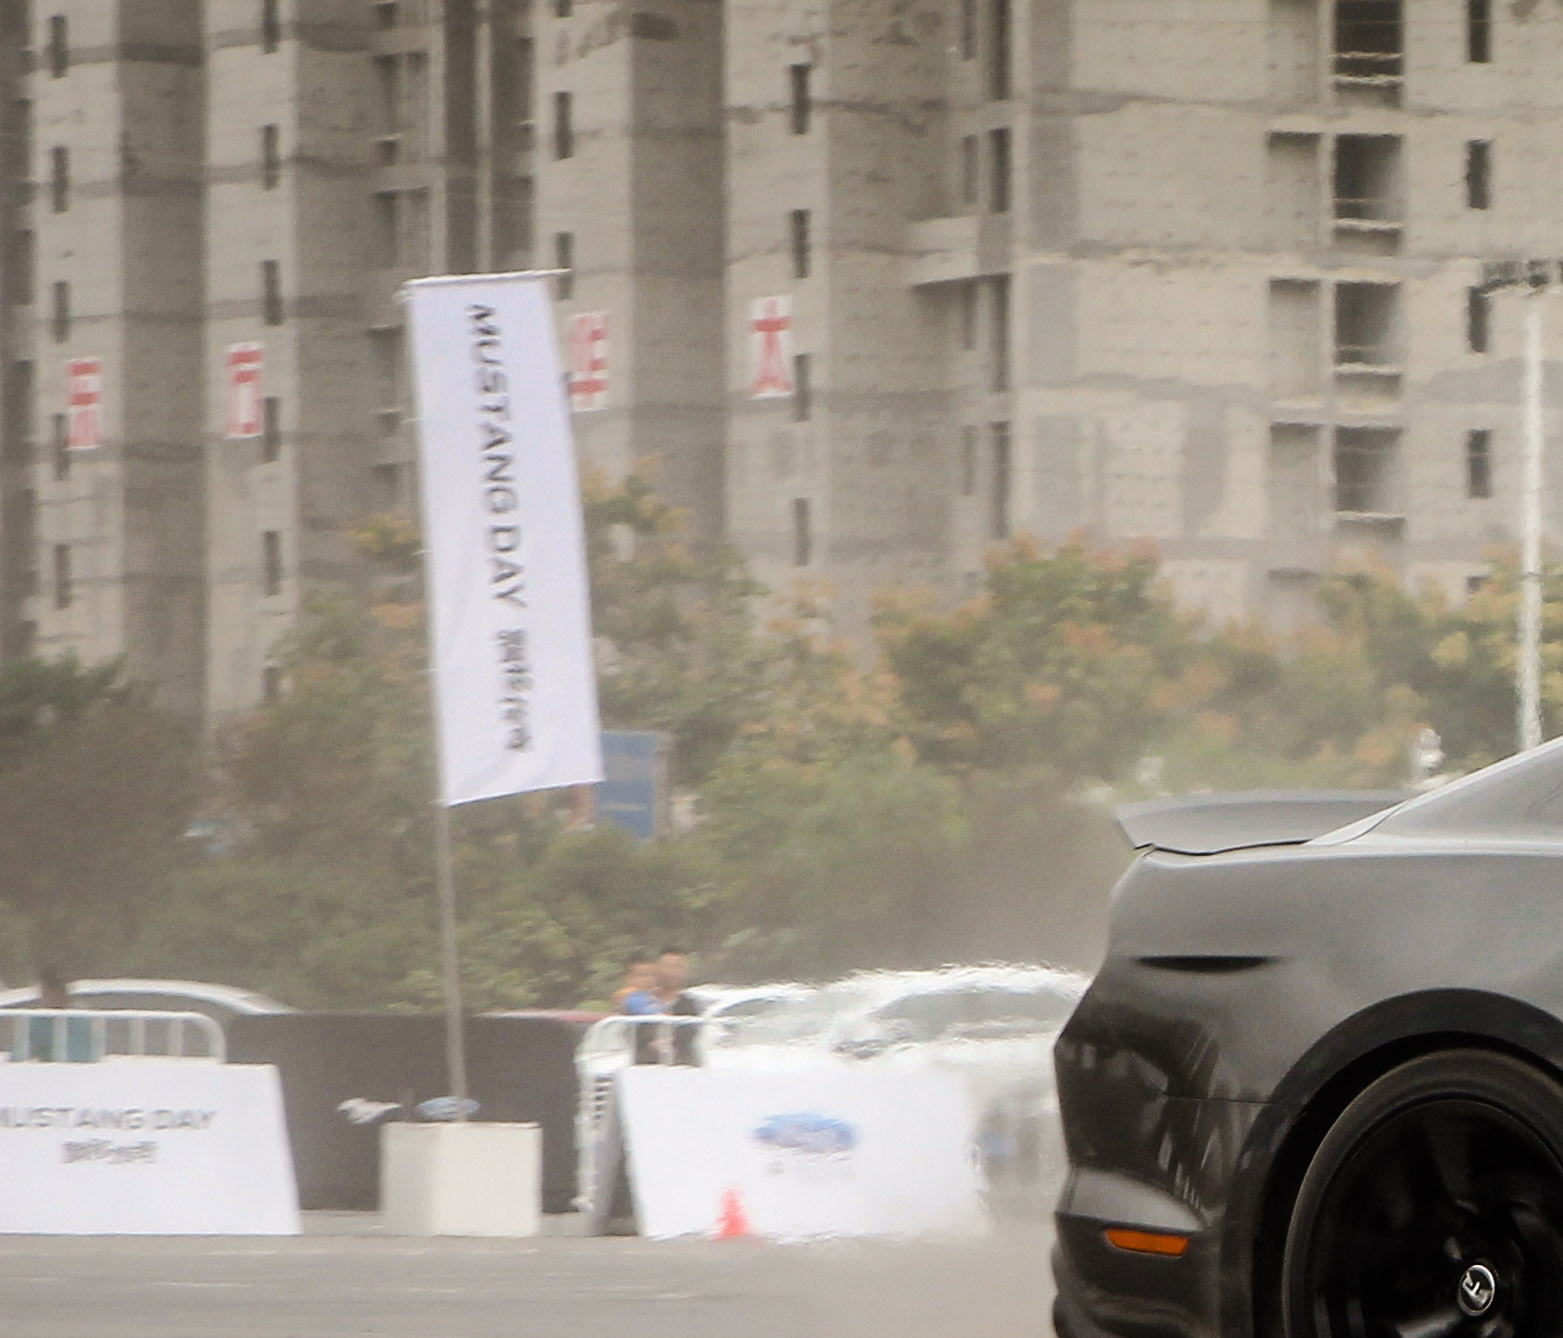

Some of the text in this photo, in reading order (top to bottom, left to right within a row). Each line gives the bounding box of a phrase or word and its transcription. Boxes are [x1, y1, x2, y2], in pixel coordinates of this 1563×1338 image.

[467, 303, 520, 514] MUSTANG
[487, 524, 528, 609] DAY
[0, 1107, 217, 1130] USTANG DAY
